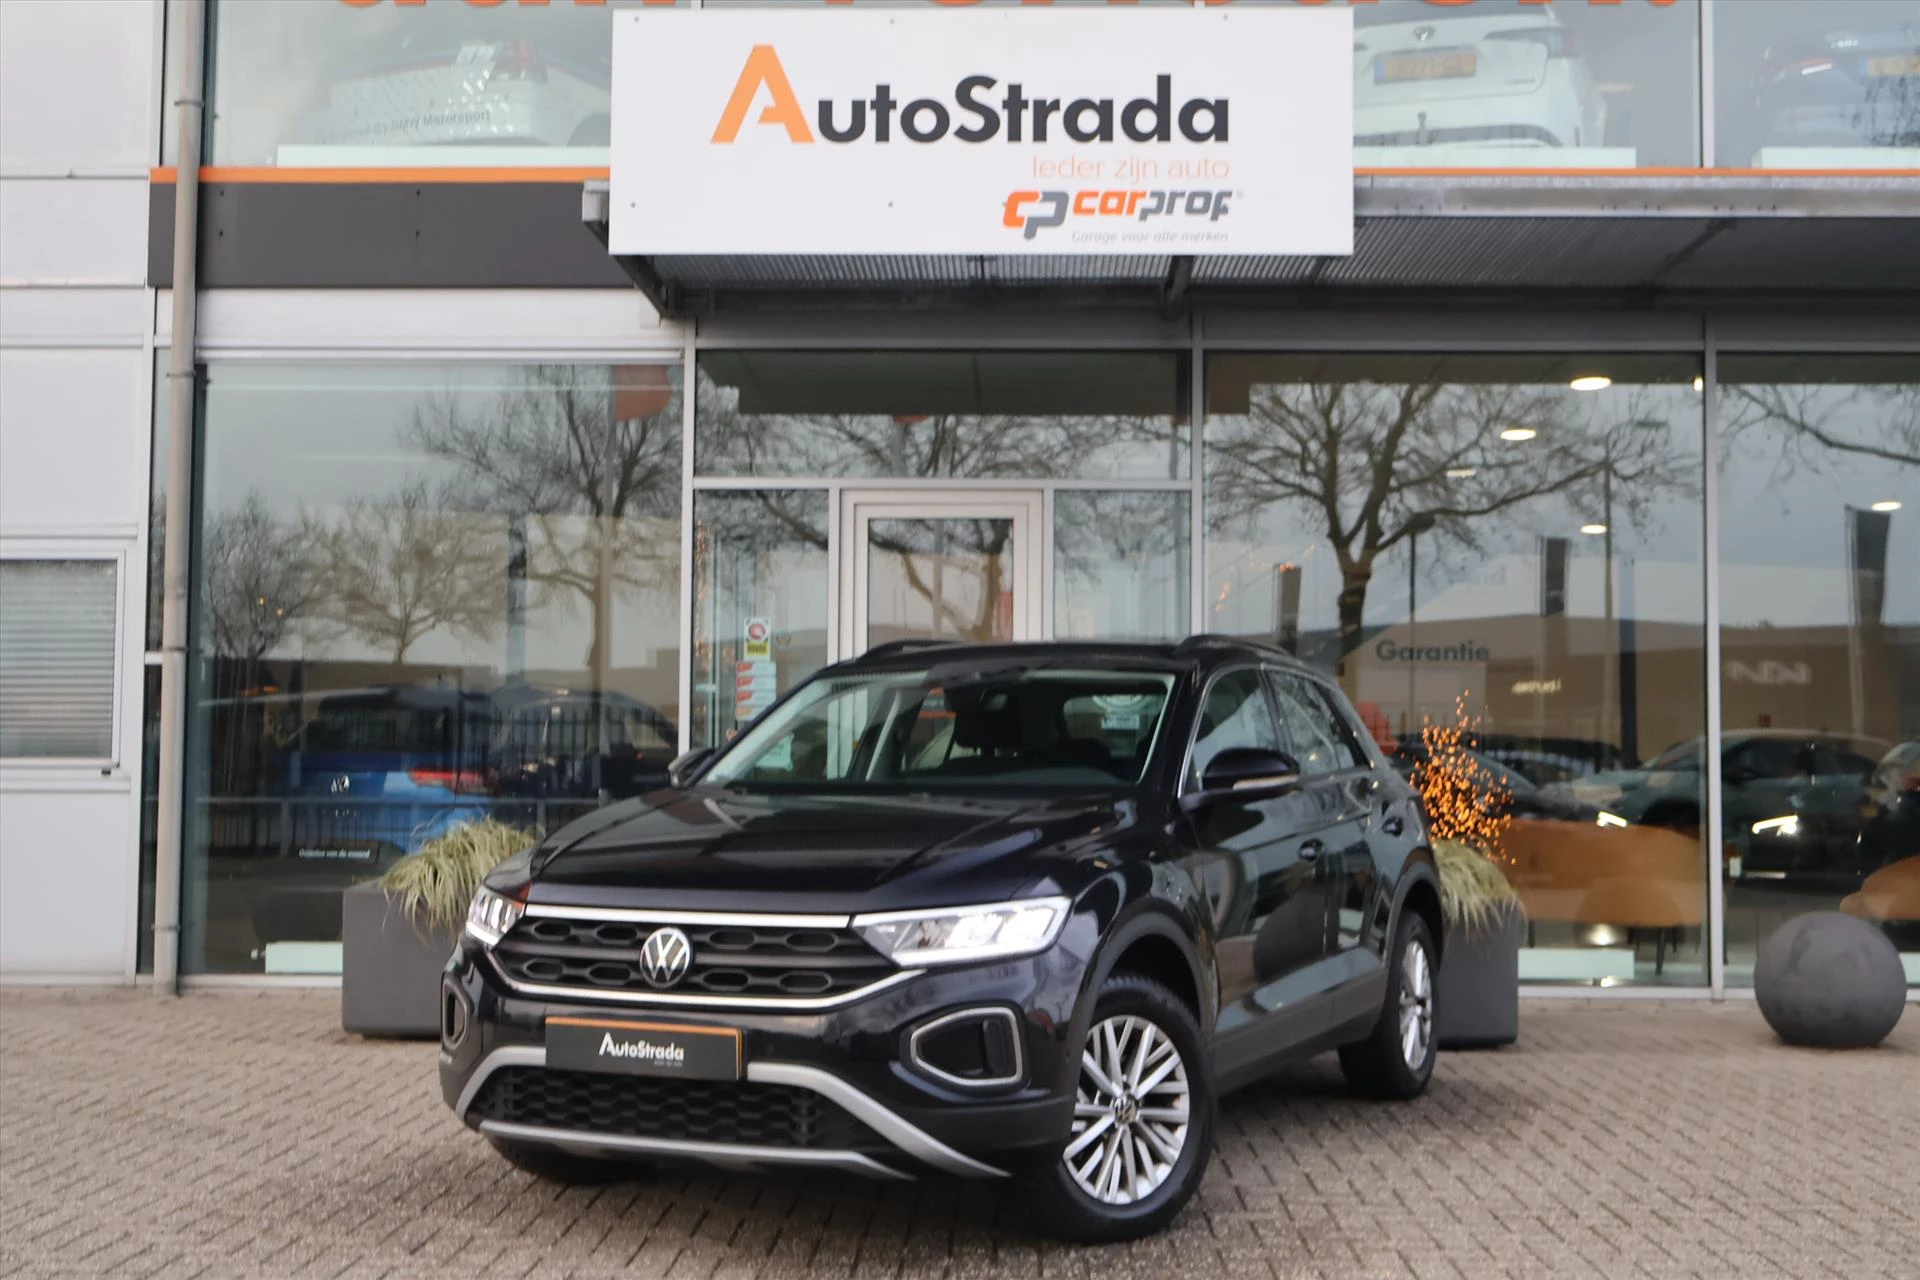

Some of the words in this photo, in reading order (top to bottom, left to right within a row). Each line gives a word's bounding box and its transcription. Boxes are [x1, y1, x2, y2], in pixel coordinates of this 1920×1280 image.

[710, 44, 1230, 145] AutoStrada
[1032, 155, 1103, 179] Ieder
[1114, 155, 1159, 184] zijn
[1167, 157, 1230, 179] auto
[1071, 230, 1118, 244] Garage
[1121, 232, 1150, 242] voor
[1153, 230, 1179, 242] alle
[1181, 230, 1229, 242] merken
[1376, 639, 1490, 662] Garantie
[598, 1031, 685, 1062] AutoStrada
